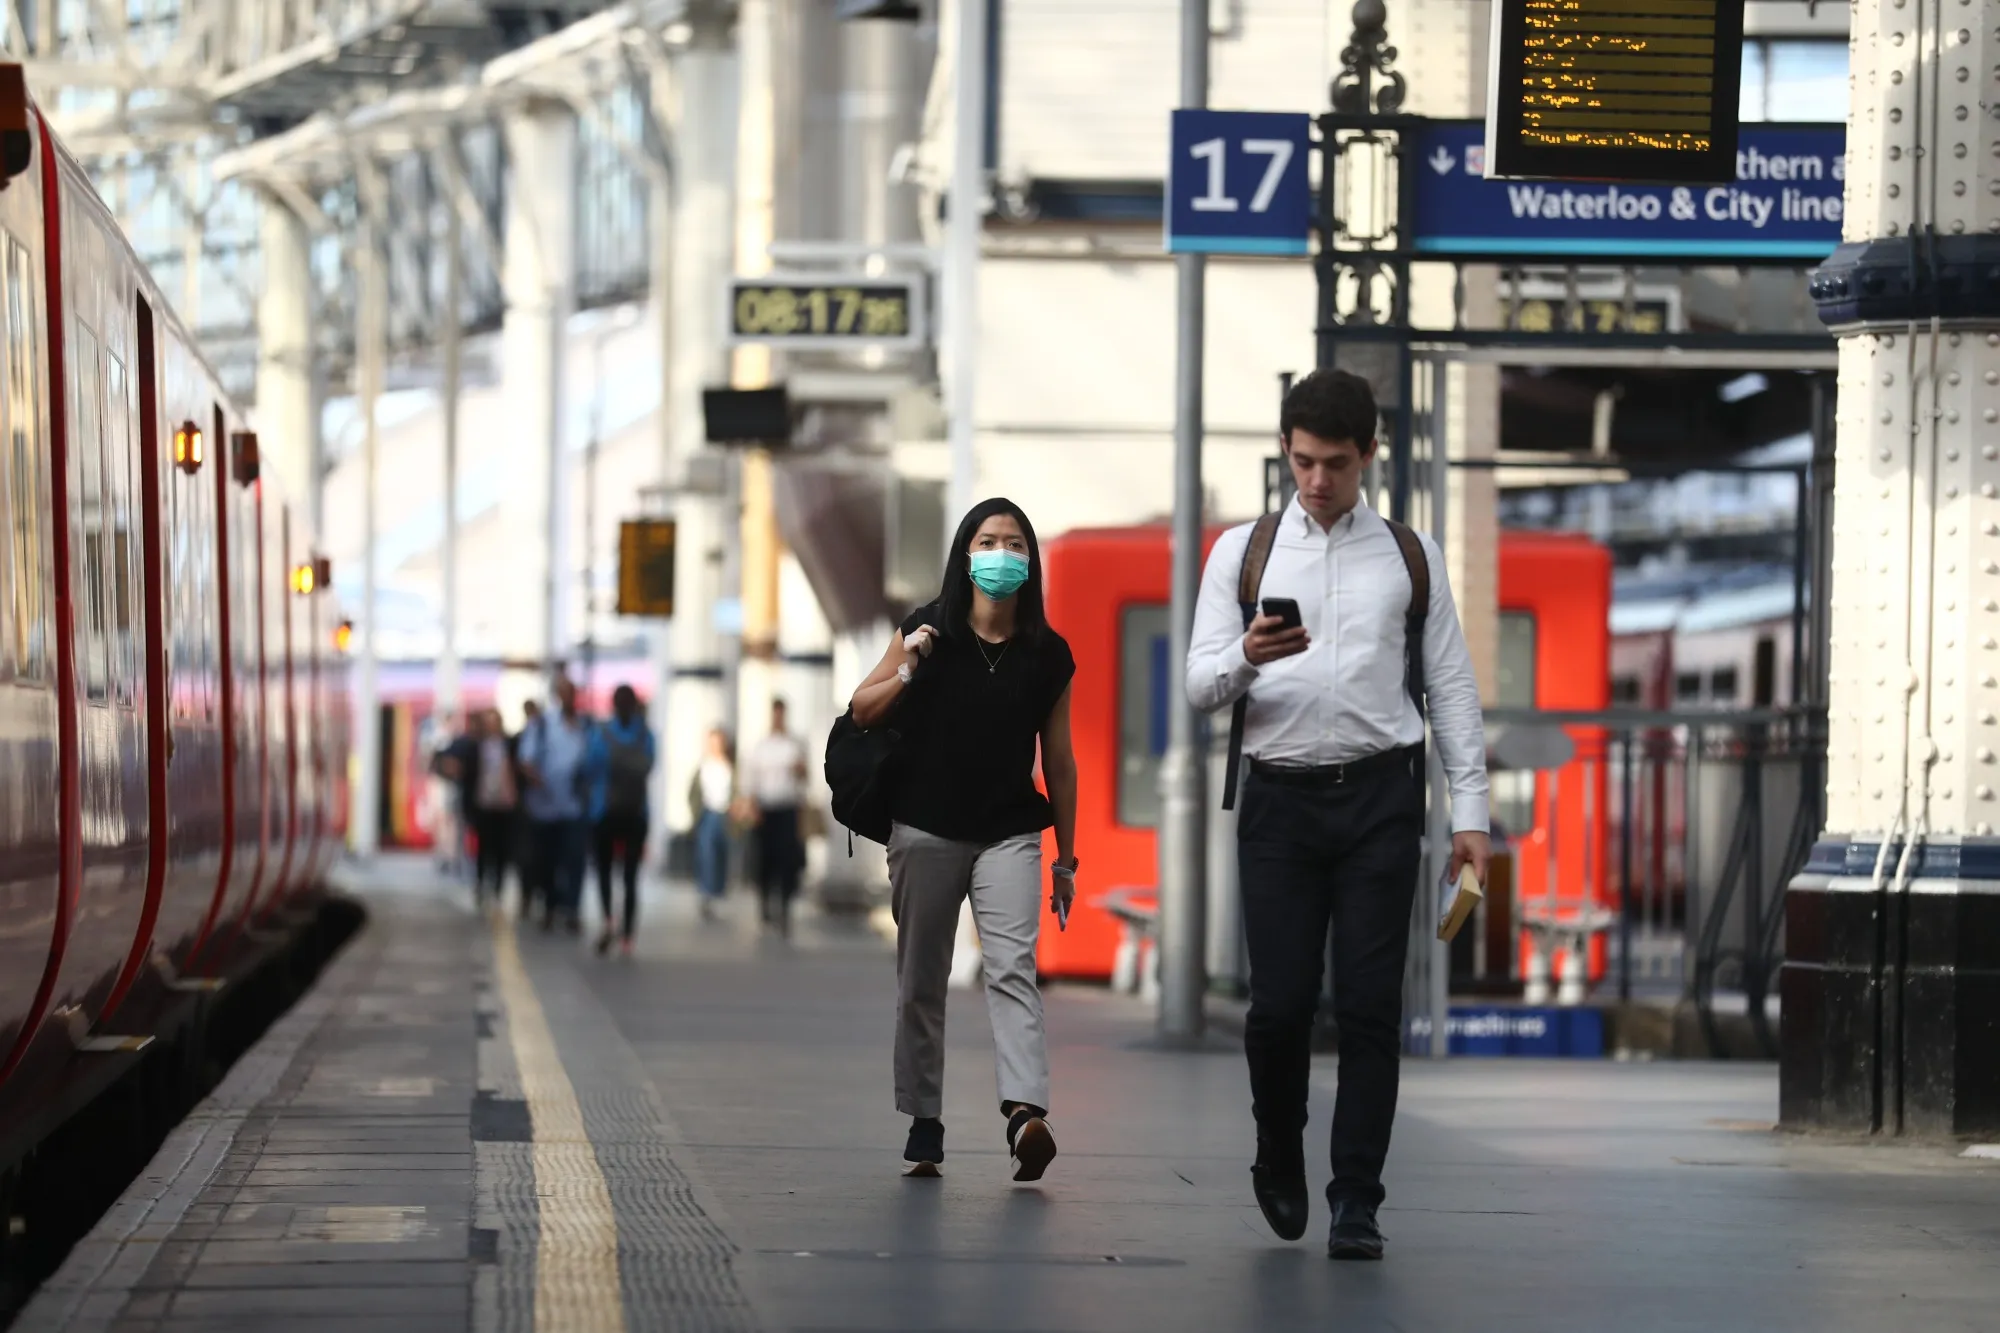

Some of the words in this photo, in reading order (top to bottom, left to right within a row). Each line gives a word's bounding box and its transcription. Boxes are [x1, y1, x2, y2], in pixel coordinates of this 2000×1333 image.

[1190, 137, 1294, 212] 17
[1736, 145, 1823, 180] thern
[1507, 184, 1662, 221] Waterloo
[1668, 185, 1697, 221] &
[1704, 186, 1775, 228] City
[736, 286, 862, 335] 08:17
